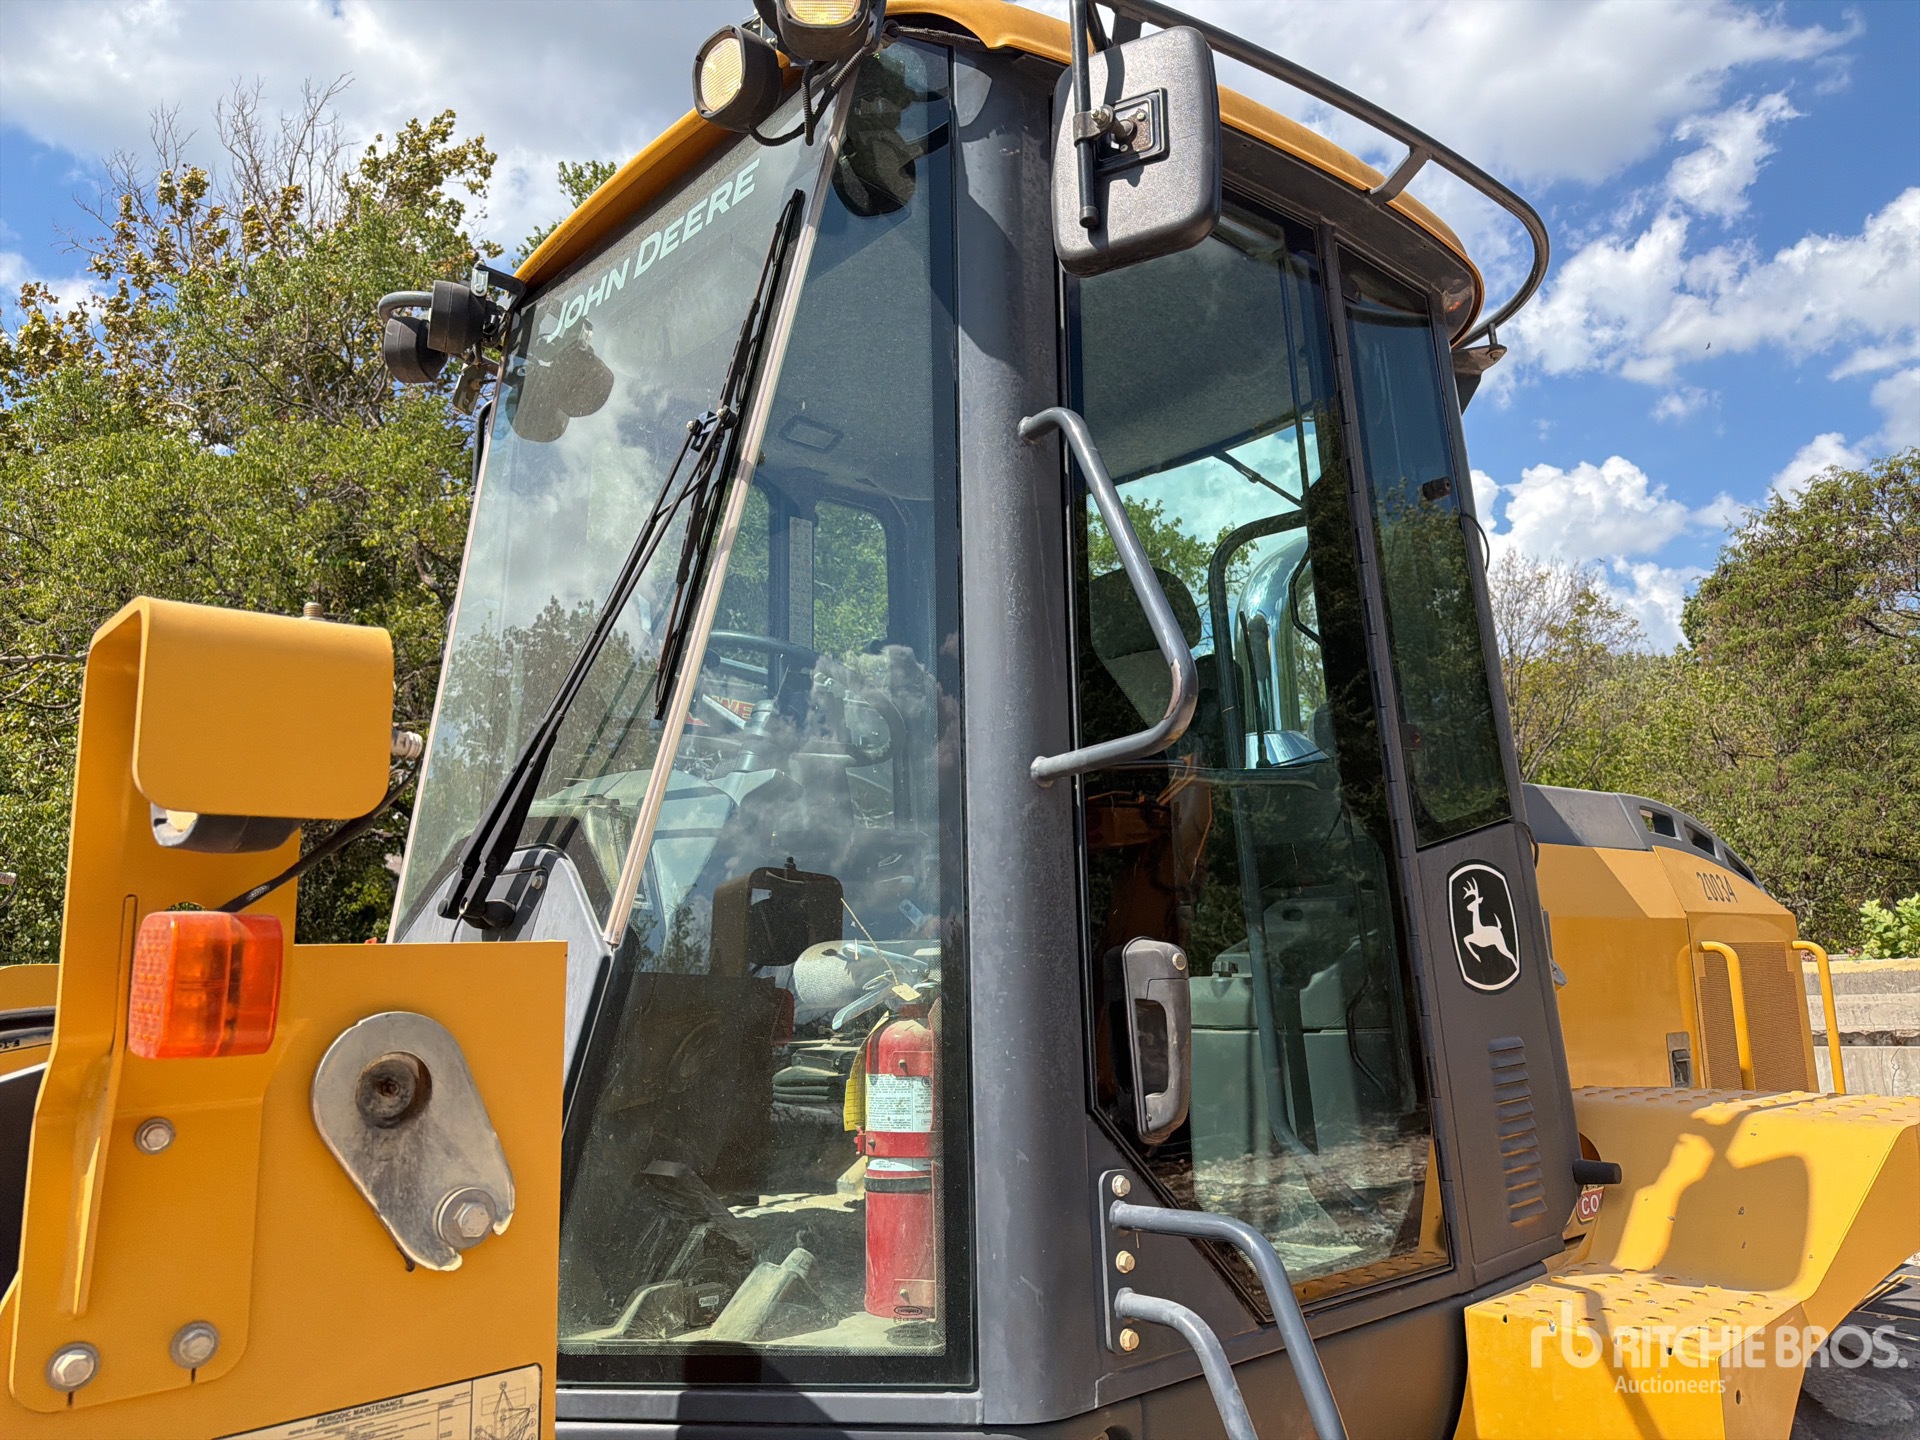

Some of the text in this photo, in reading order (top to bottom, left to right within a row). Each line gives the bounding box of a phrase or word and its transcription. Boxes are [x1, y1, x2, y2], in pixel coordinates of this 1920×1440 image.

[547, 158, 760, 343] JOHN DEERE
[1696, 872, 1738, 903] 20034
[1581, 1192, 1602, 1215] CO
[316, 1398, 404, 1425] PERIODIC MAINTENANCE
